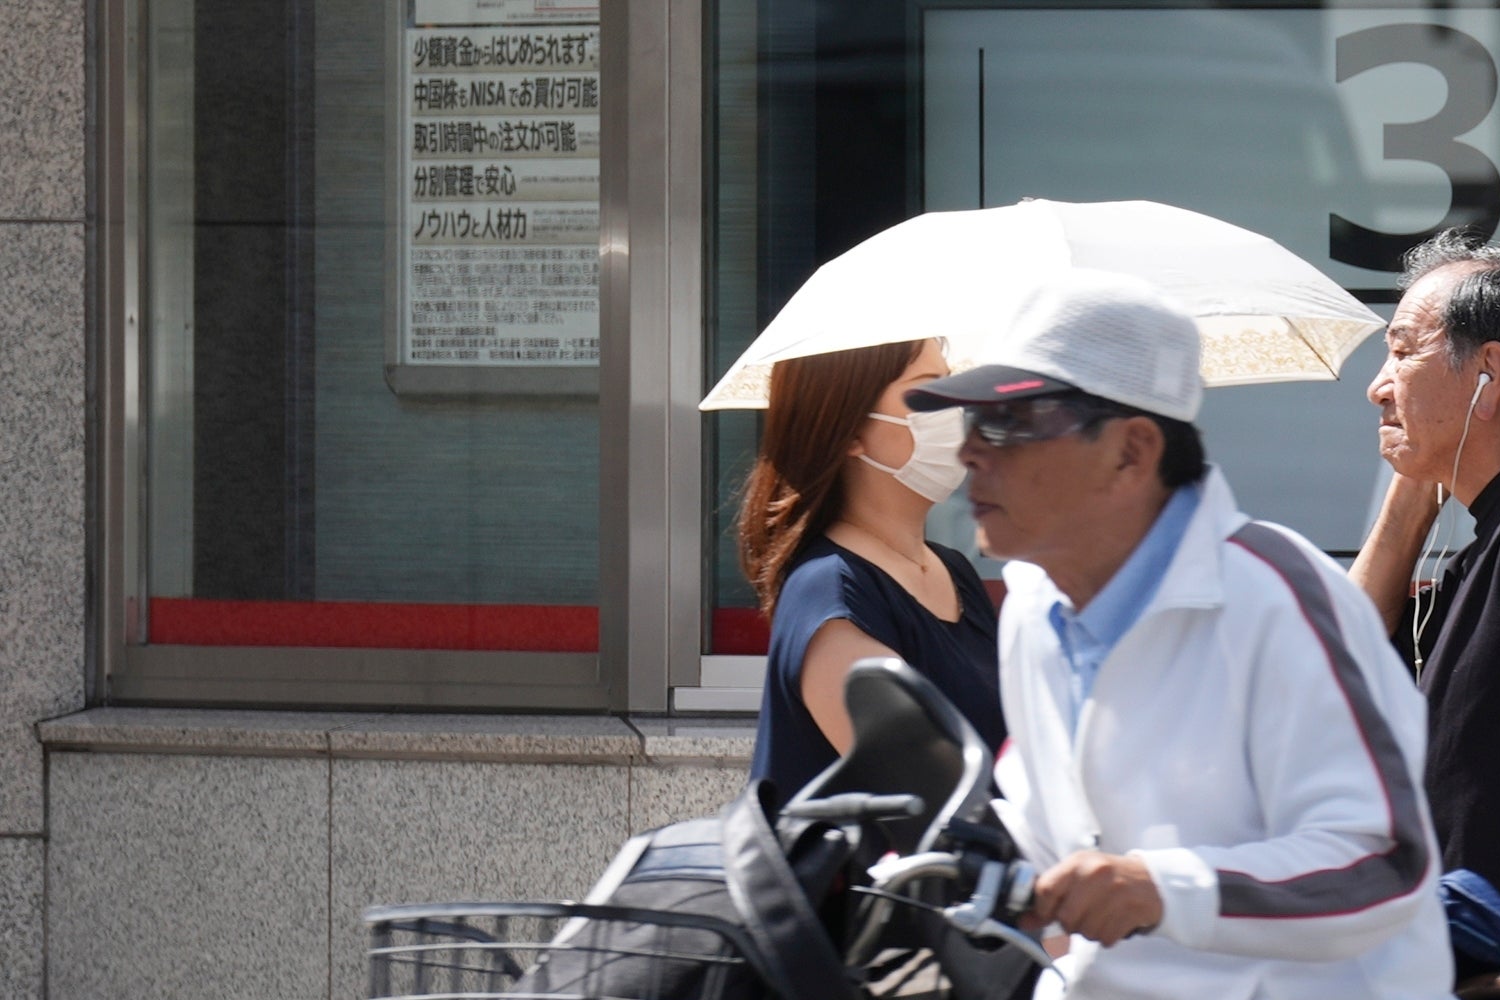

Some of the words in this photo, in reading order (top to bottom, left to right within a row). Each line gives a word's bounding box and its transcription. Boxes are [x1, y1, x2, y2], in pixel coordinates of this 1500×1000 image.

[414, 77, 598, 110] 中国株もNISAでお買付可能
[414, 121, 577, 154] 取引時間中の注文が可能
[414, 165, 516, 197] 分別管理で安心
[414, 207, 527, 240] ノウハウと人材力
